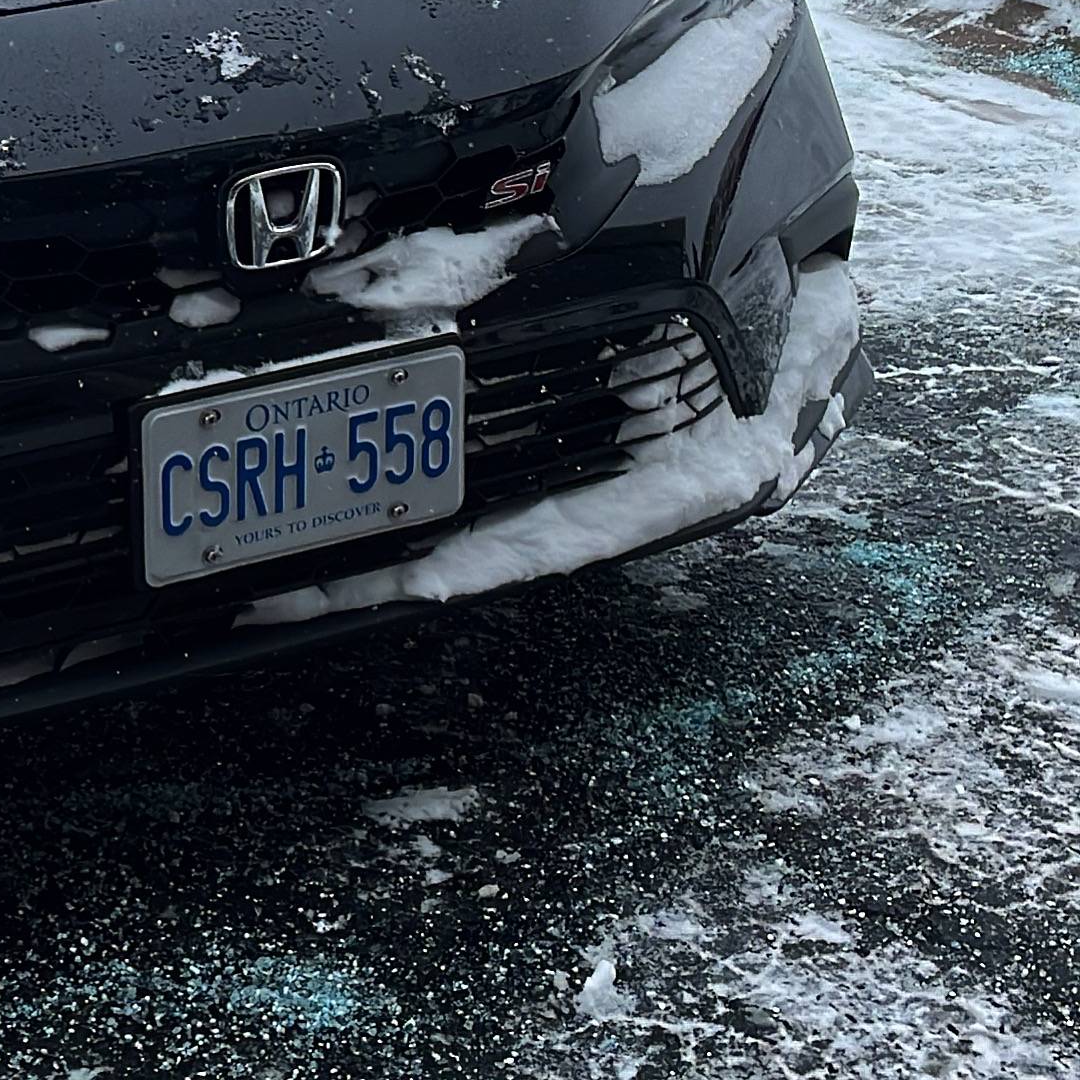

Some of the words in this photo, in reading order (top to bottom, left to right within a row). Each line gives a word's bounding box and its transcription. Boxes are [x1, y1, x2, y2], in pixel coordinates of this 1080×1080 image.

[484, 161, 551, 209] Si
[246, 384, 371, 432] ONTARIO
[161, 426, 307, 536] CSRH
[348, 399, 452, 494] 558
[235, 525, 282, 546] YOURS
[287, 519, 307, 534] TO
[312, 501, 382, 529] DISCOVER
